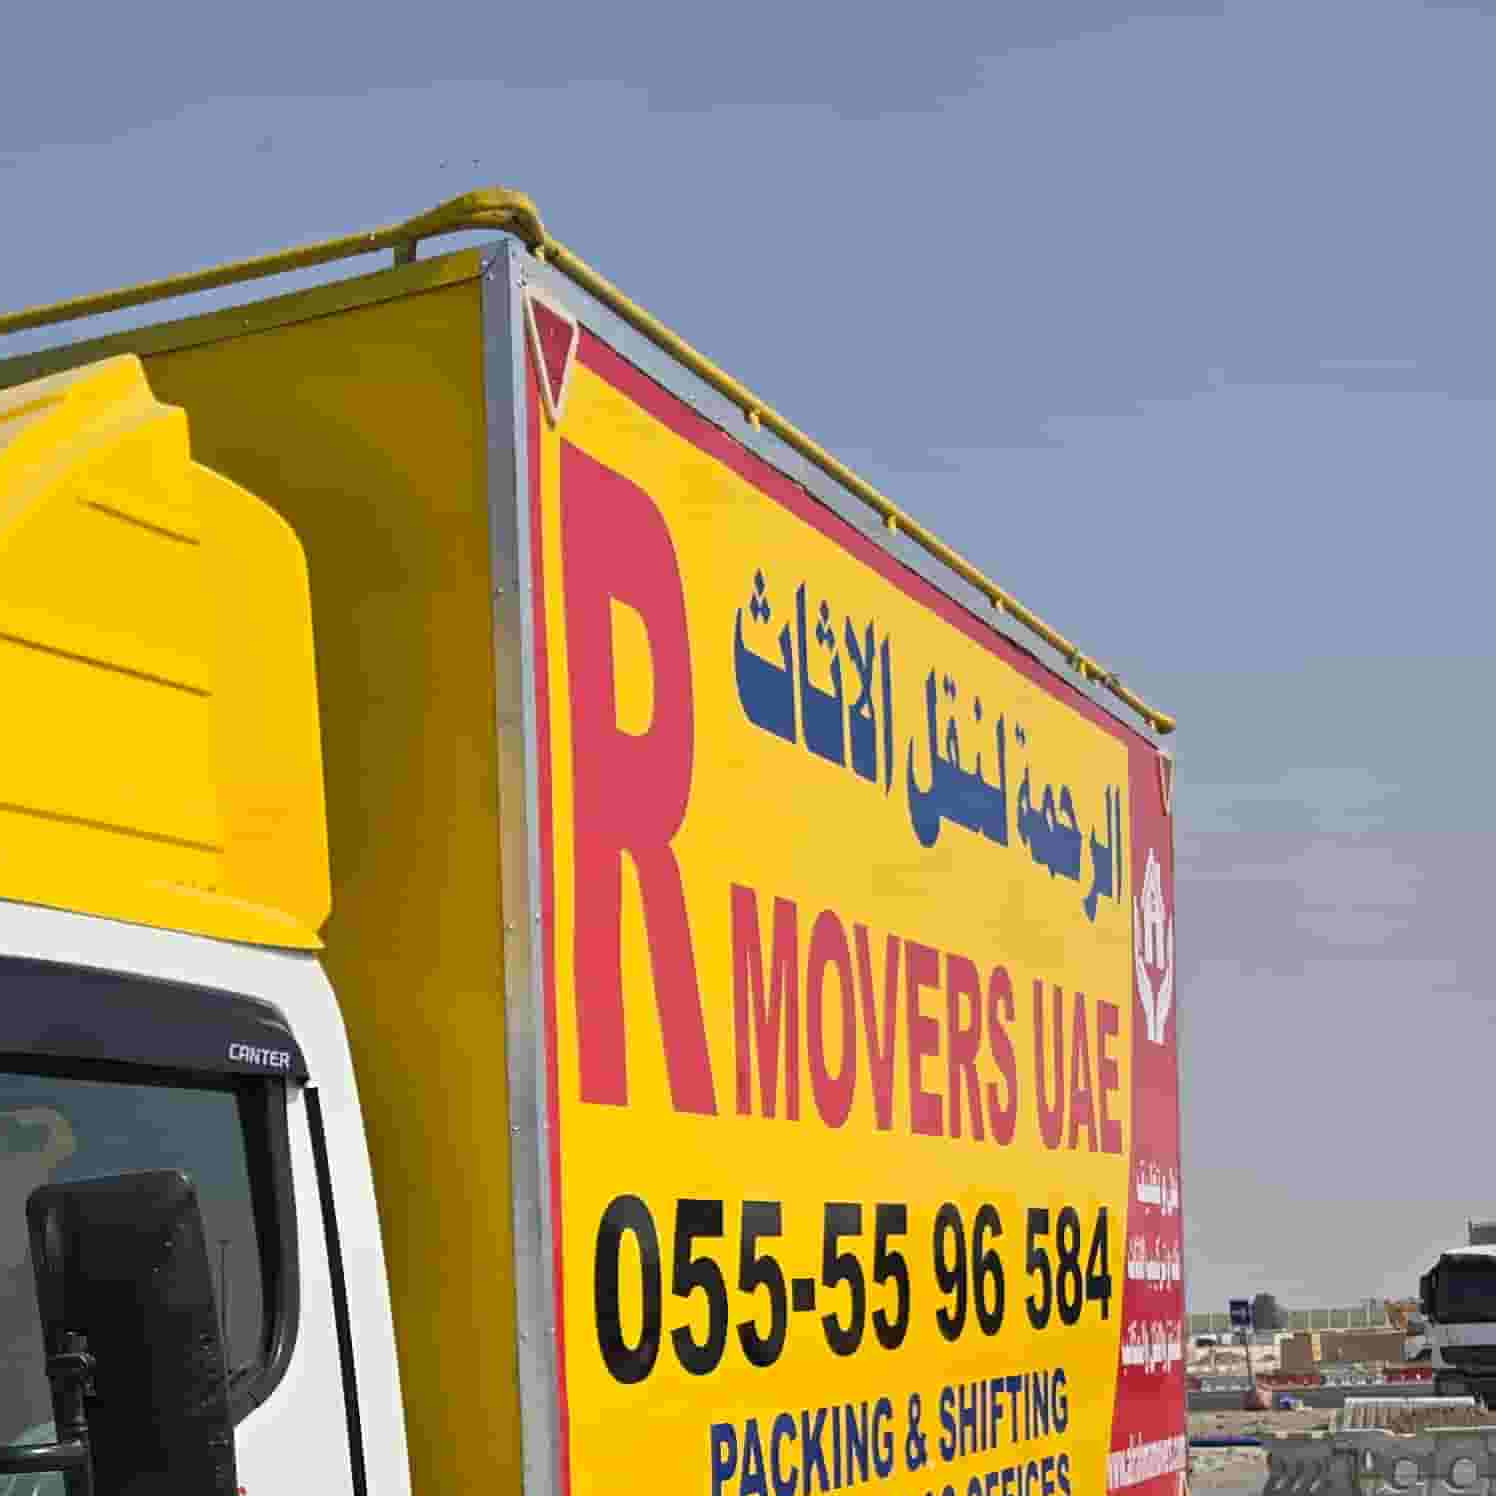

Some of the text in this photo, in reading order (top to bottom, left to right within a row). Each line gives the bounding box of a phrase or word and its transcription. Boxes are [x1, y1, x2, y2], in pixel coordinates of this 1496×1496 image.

[559, 436, 1124, 1156] R MOVERS UAE
[906, 664, 1009, 850] لنقل
[227, 1041, 291, 1070] CANTER
[593, 1194, 911, 1386] 055-55
[933, 1202, 1006, 1343] 96
[1024, 1206, 1113, 1332] 584
[904, 1391, 929, 1473] &
[938, 1367, 1069, 1463] SHIFTING
